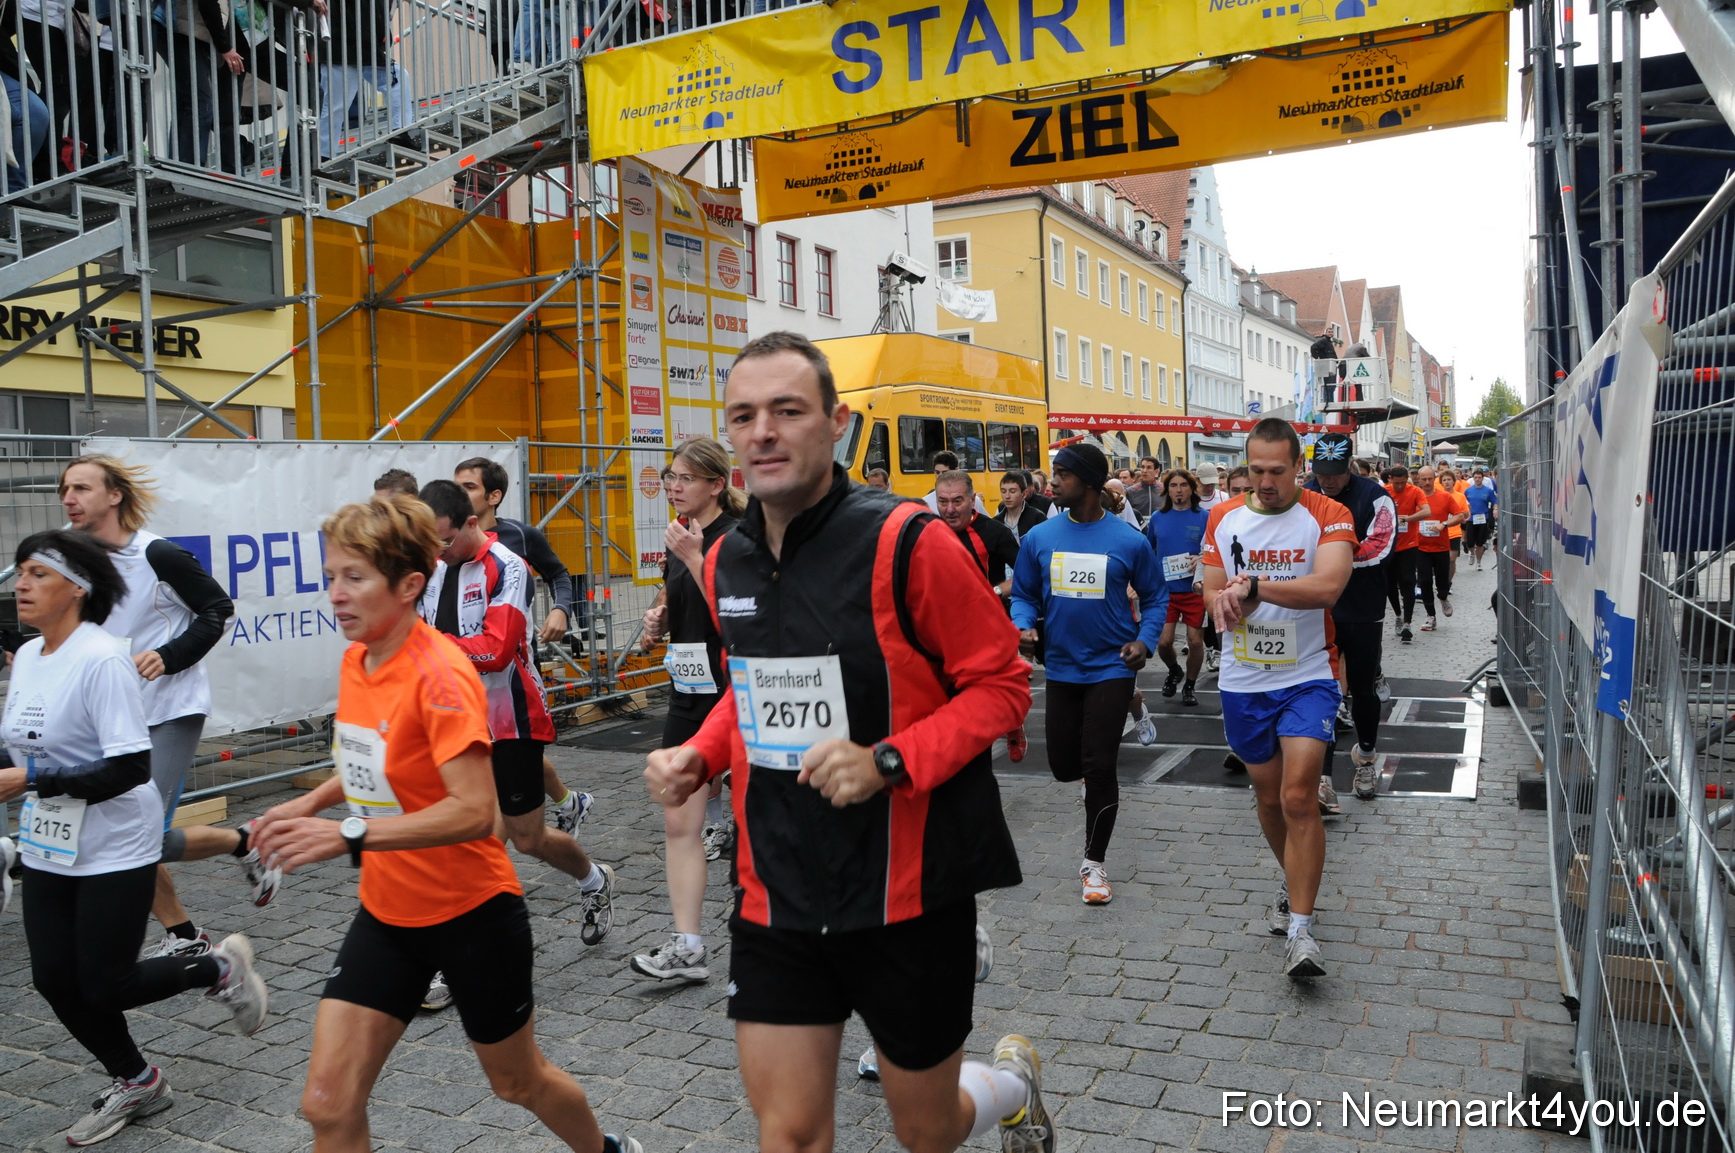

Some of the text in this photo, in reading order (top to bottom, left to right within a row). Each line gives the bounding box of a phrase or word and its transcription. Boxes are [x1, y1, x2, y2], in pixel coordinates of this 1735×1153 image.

[619, 79, 785, 121] Neumarkter Stadtlauf
[1278, 75, 1464, 119] Neumarkter Stadtlauf
[1010, 90, 1179, 168] ZIEL
[784, 158, 925, 190] Neumarkter Stadtlauf
[702, 202, 743, 221] MERZ
[632, 250, 648, 260] KANN
[627, 318, 657, 332] Sinupret
[714, 314, 747, 334] OBI
[75, 315, 203, 360] WEBER
[628, 332, 646, 345] forte
[638, 356, 660, 365] Egner
[919, 393, 951, 405] SPORTRONIC
[994, 403, 1025, 415] EVENT SERVICE
[1060, 416, 1085, 424] Service
[1123, 418, 1158, 426] Serviceline:
[632, 435, 664, 443] HACKNER
[1324, 522, 1354, 533] MERZ
[1249, 549, 1306, 563] MERZ
[1246, 558, 1293, 571] Reisen
[1069, 570, 1096, 584] 226
[1247, 624, 1285, 638] Wolfgang
[1253, 641, 1285, 655] 422
[675, 663, 705, 677] 2928
[755, 667, 822, 689] Bernhard
[762, 701, 832, 729] 2670
[34, 817, 72, 841] 2175
